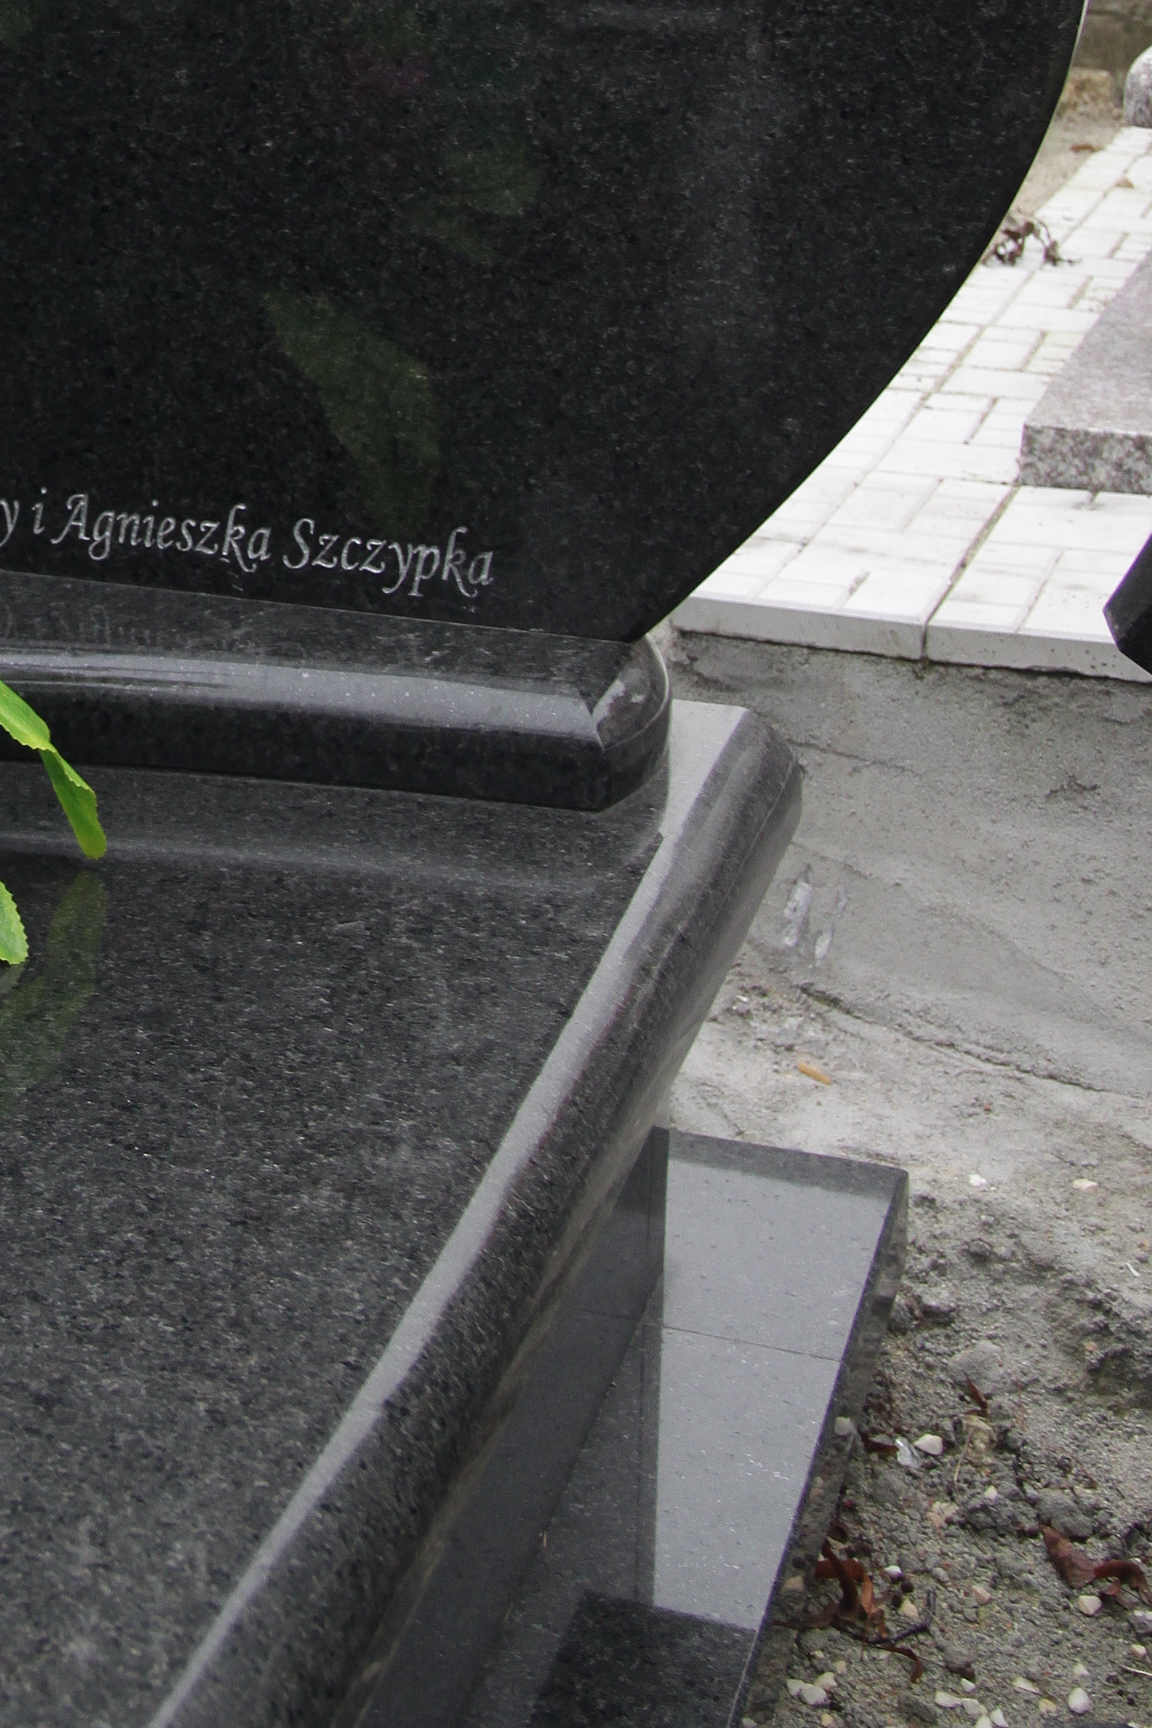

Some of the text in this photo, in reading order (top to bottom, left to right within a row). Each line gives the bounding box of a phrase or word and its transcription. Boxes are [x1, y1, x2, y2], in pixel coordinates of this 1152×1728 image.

[32, 487, 47, 536] i
[51, 492, 272, 573] Agnieszka
[283, 517, 495, 599] Szczypka
